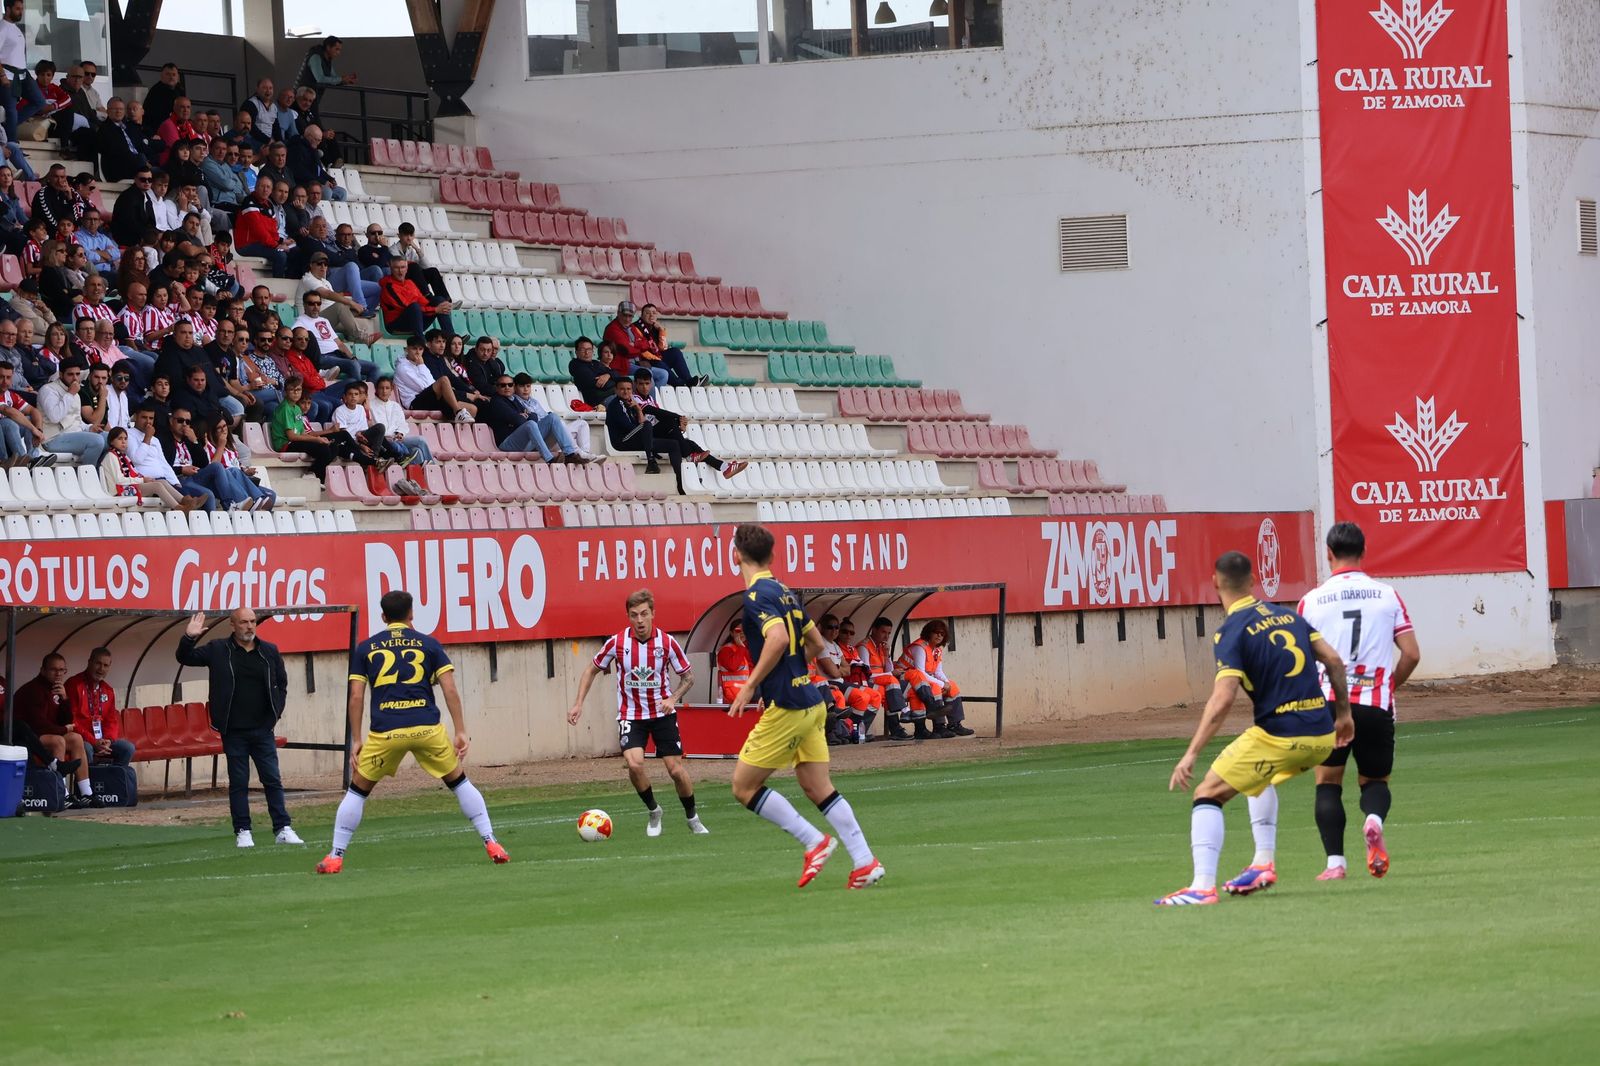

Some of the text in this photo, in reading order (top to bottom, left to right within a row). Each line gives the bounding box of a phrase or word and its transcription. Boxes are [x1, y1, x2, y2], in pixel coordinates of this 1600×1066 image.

[1334, 65, 1492, 92] CAJA RURAL
[1363, 94, 1465, 110] DE ZAMORA
[1342, 271, 1499, 299] CAJA RURAL
[1370, 300, 1472, 317] DE ZAMORA
[1350, 477, 1507, 506] CAJA RURAL
[1379, 506, 1481, 523] DE ZAMORA
[786, 534, 815, 573] DE
[831, 532, 908, 572] STAND
[1144, 519, 1177, 603] CF
[0, 543, 149, 604] RÓTULOS
[172, 546, 326, 623] Gráficas
[364, 533, 547, 639] DUERO
[1341, 586, 1383, 601] MÁRQUEZ
[1246, 614, 1294, 636] LANCHO
[1342, 609, 1362, 661] 7
[370, 634, 423, 651] E. VERGÉS
[1268, 629, 1306, 678] 3
[367, 648, 426, 689] 23
[640, 680, 660, 688] RURAL
[620, 719, 632, 735] 15
